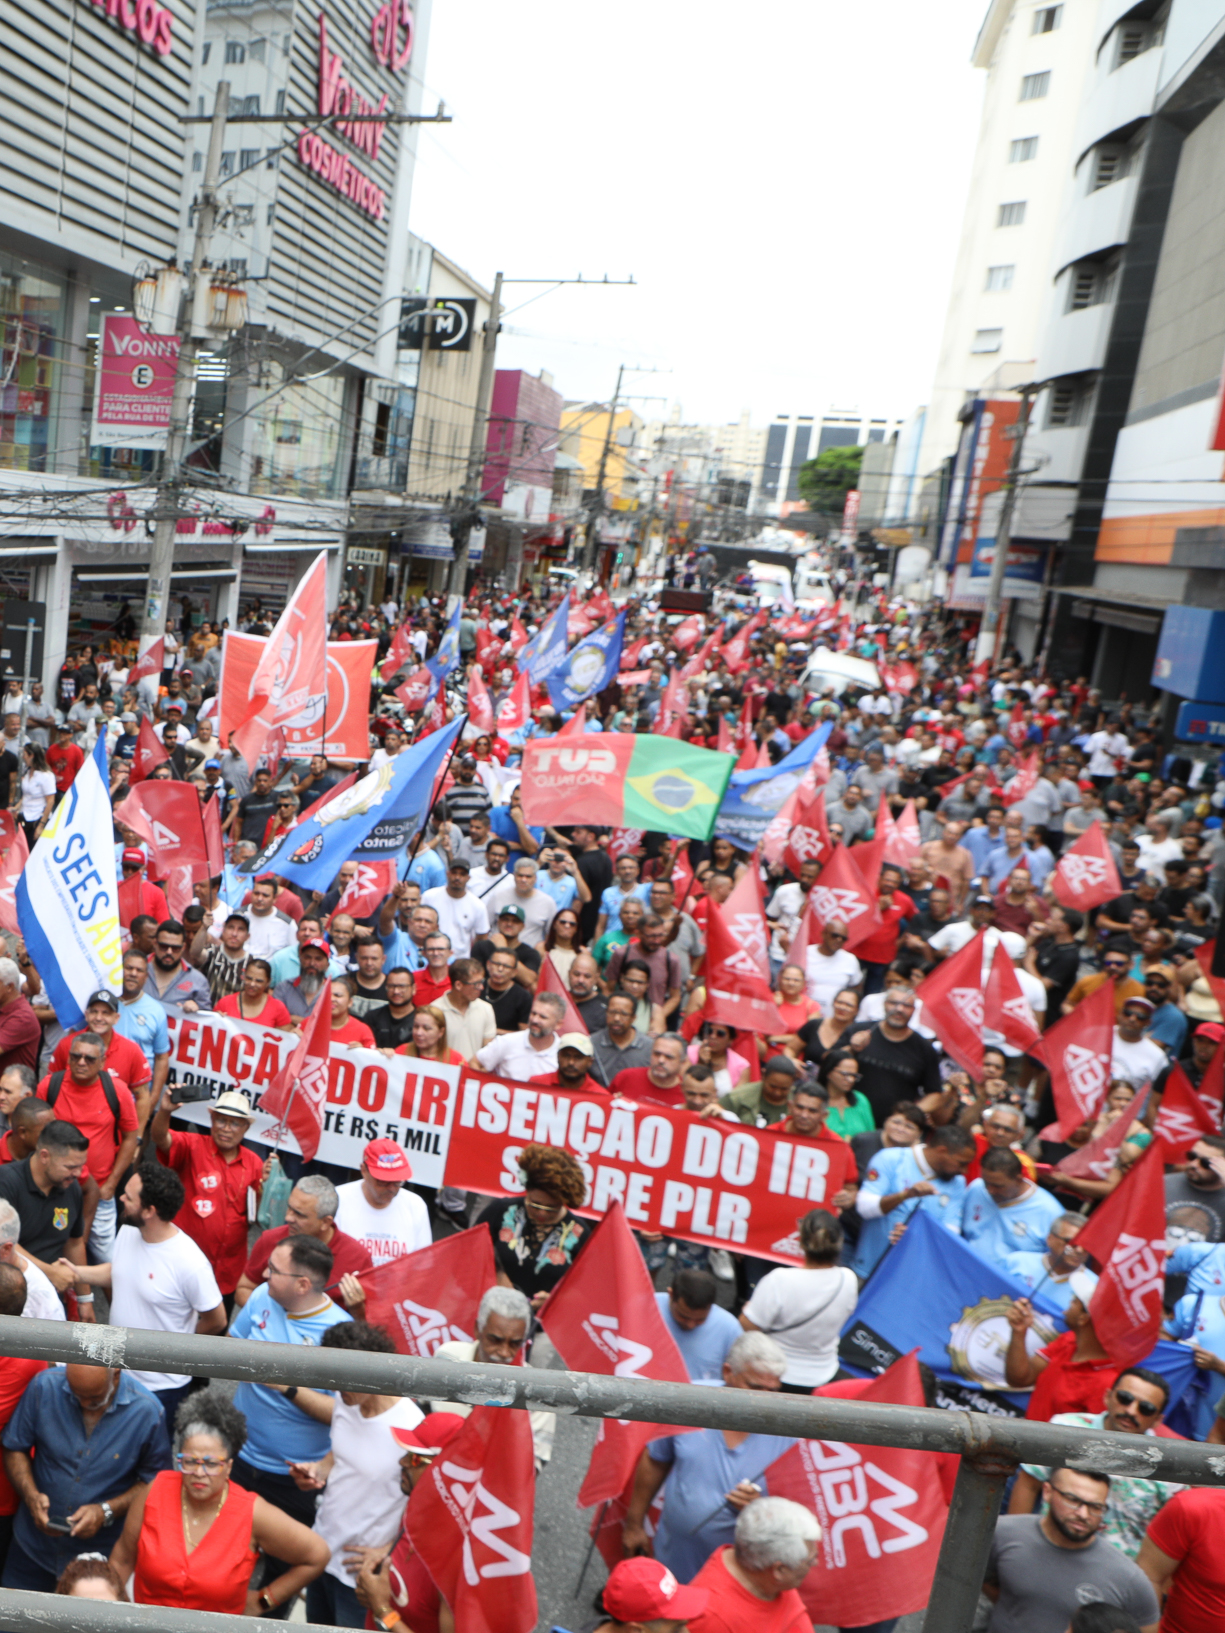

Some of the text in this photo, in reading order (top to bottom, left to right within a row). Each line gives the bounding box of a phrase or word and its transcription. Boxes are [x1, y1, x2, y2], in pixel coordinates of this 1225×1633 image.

[298, 128, 385, 220] COSMÉTICOS
[137, 367, 148, 385] E
[103, 402, 130, 412] PARA
[52, 832, 110, 922] SEES
[326, 1056, 389, 1113] DO
[399, 1072, 450, 1127] IR
[324, 1110, 345, 1135] TÉ
[350, 1117, 379, 1142] R$
[385, 1124, 399, 1142] 5
[404, 1128, 442, 1156] MIL
[460, 1079, 830, 1203] ISENÇÃO DO IR
[201, 1175, 217, 1189] 13
[499, 1145, 752, 1244] SBRE PLR
[196, 1199, 212, 1212] 13
[359, 1237, 408, 1258] ORNADA
